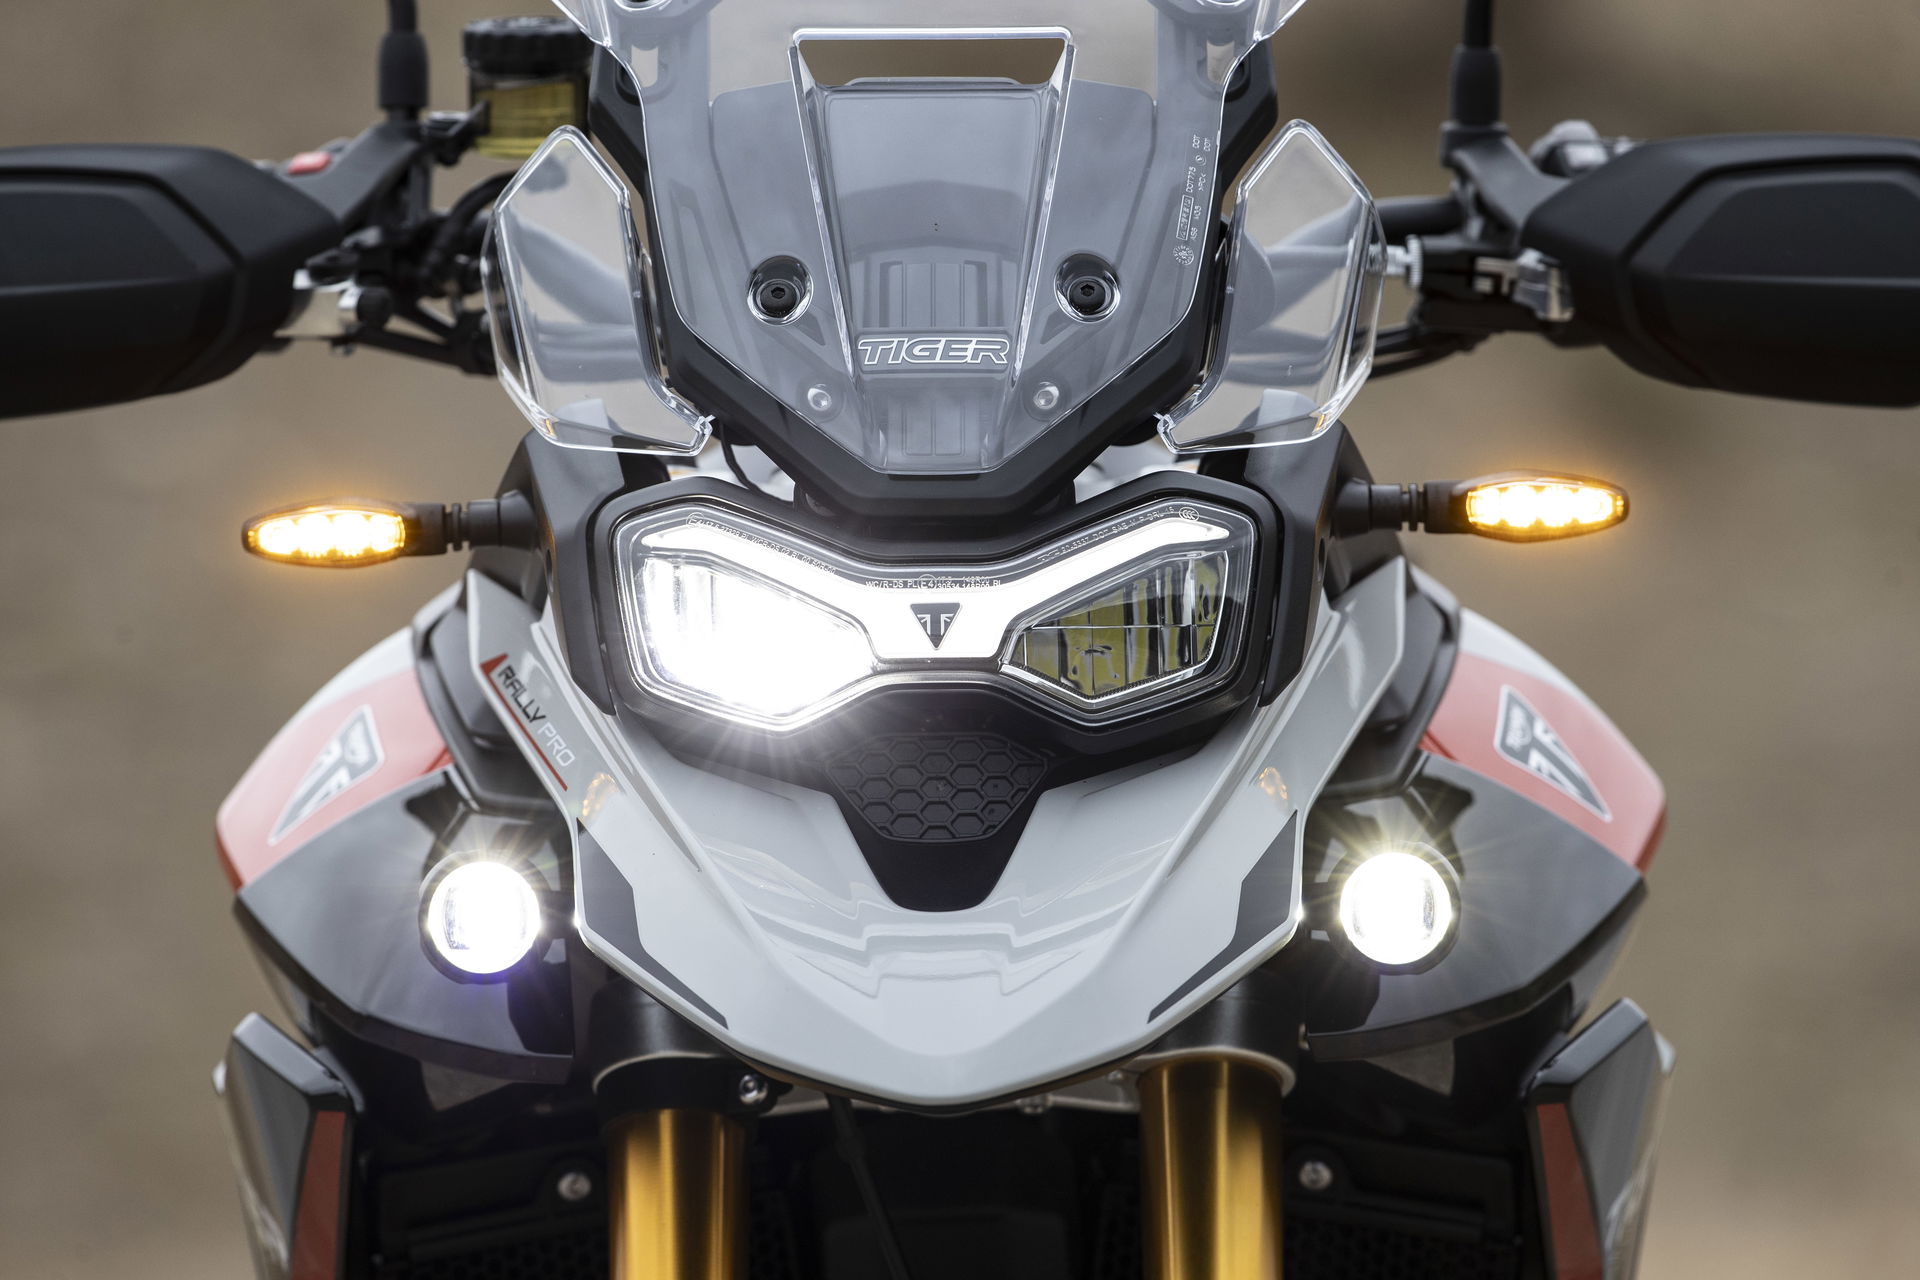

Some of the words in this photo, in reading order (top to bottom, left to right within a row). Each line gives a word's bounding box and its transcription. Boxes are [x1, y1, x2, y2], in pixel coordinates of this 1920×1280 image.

[858, 337, 1010, 365] TIGER
[498, 666, 546, 722] RALLY
[537, 722, 575, 767] PRO
